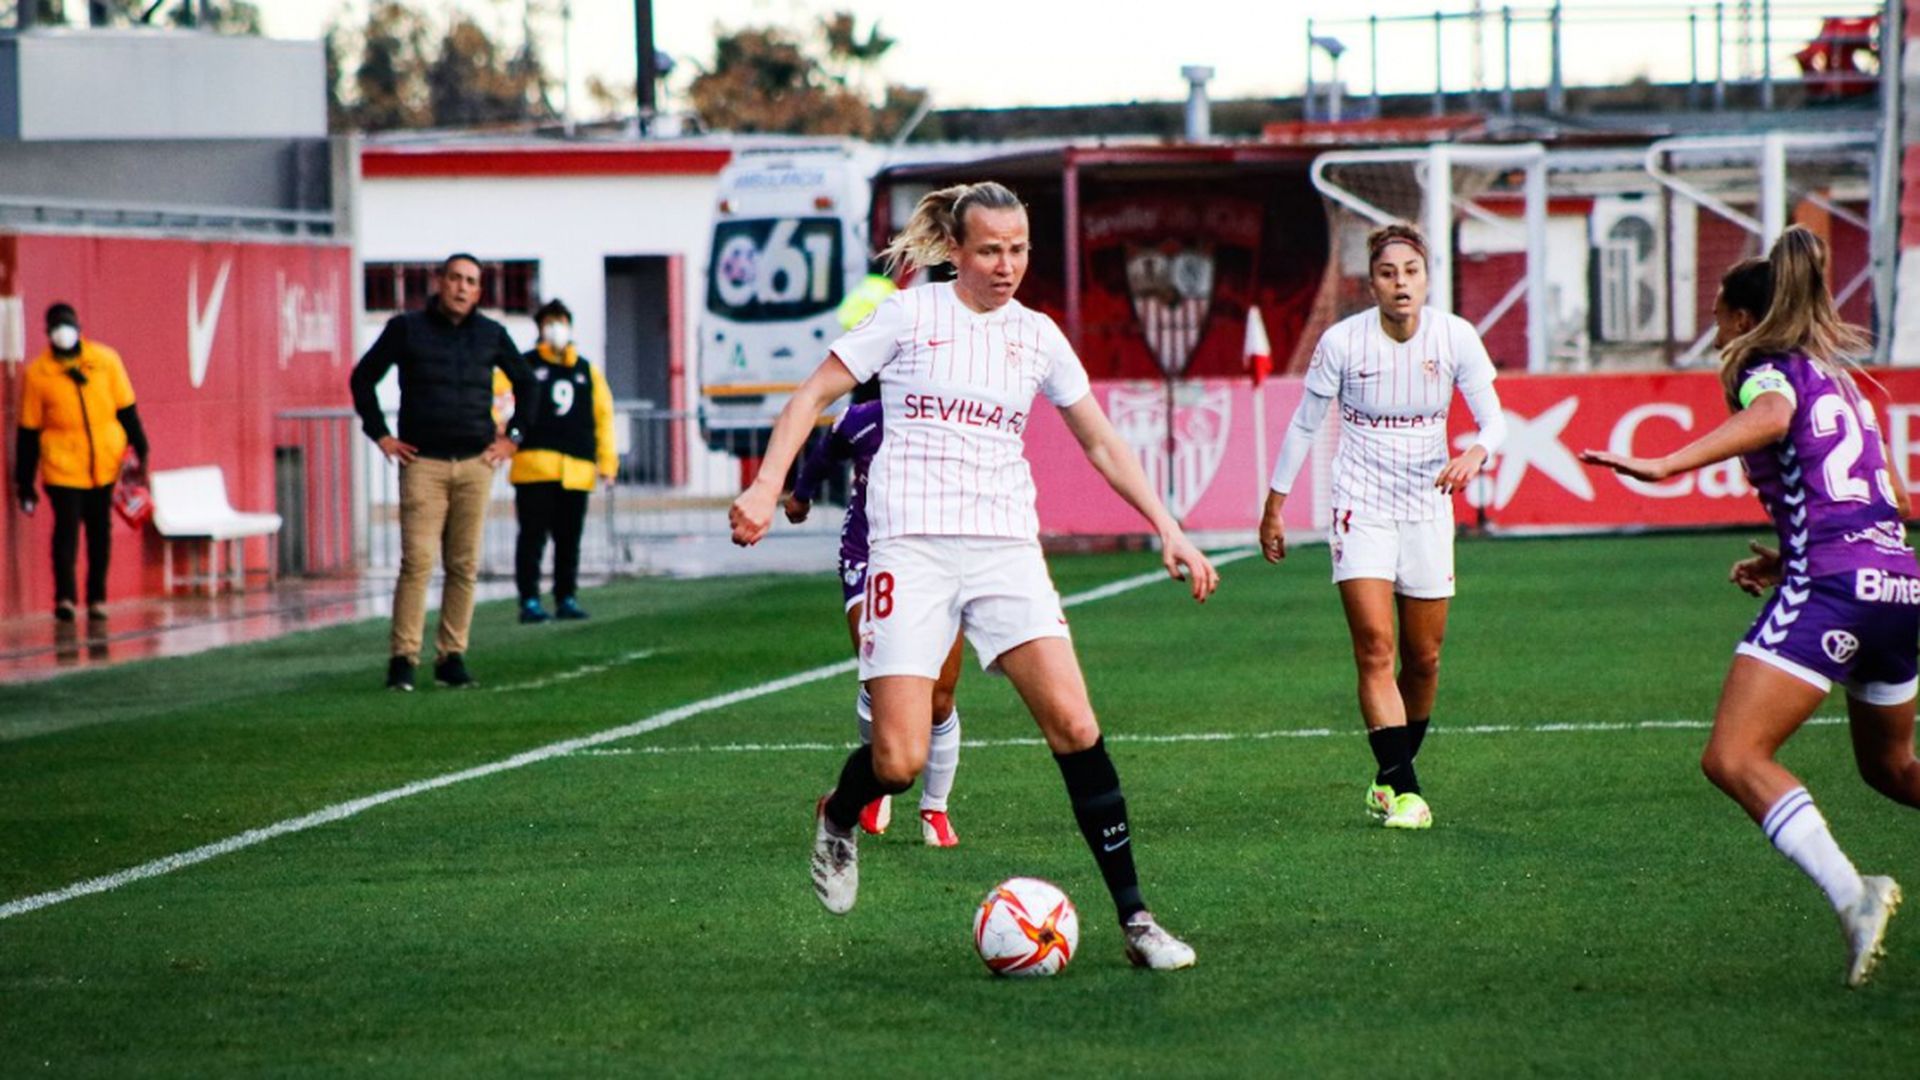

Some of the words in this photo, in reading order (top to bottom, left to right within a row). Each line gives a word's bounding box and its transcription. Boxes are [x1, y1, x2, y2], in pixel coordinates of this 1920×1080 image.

[552, 379, 574, 416] 9
[904, 393, 1003, 430] SEVILLA
[866, 571, 895, 622] 18
